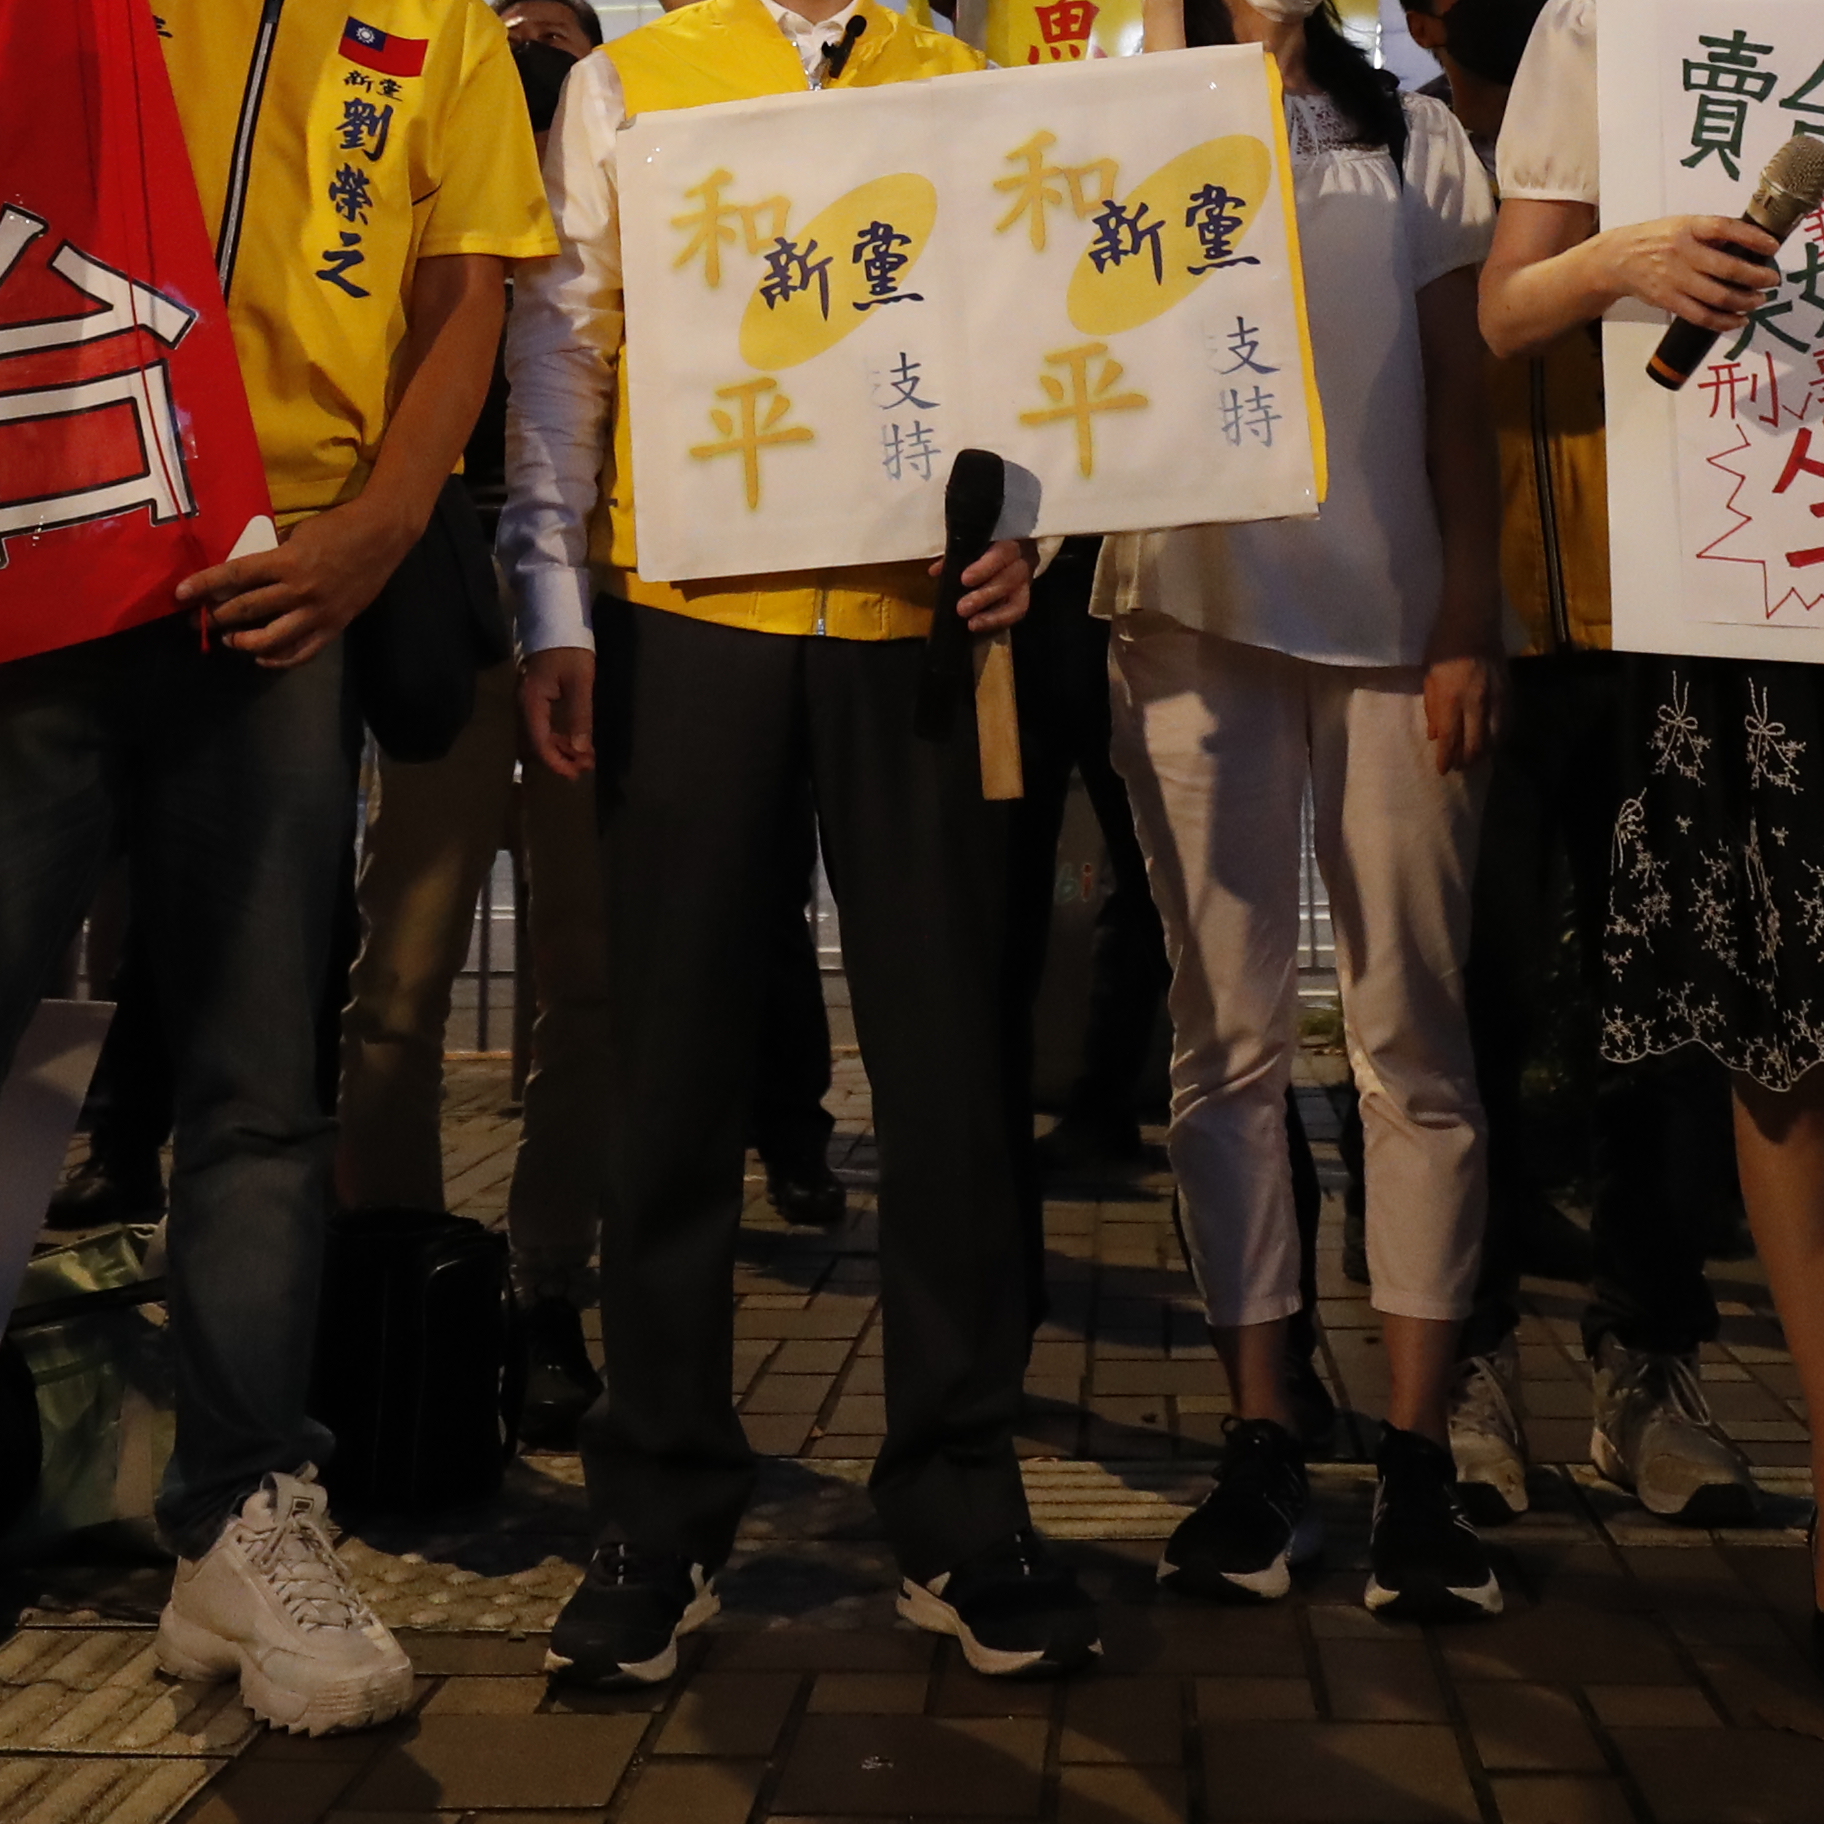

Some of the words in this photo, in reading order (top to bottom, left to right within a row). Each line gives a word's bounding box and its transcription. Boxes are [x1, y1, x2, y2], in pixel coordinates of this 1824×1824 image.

[762, 221, 924, 321] 新黨
[1088, 183, 1262, 285] 新黨
[880, 351, 941, 482] 支持
[1219, 316, 1282, 448] 支持
